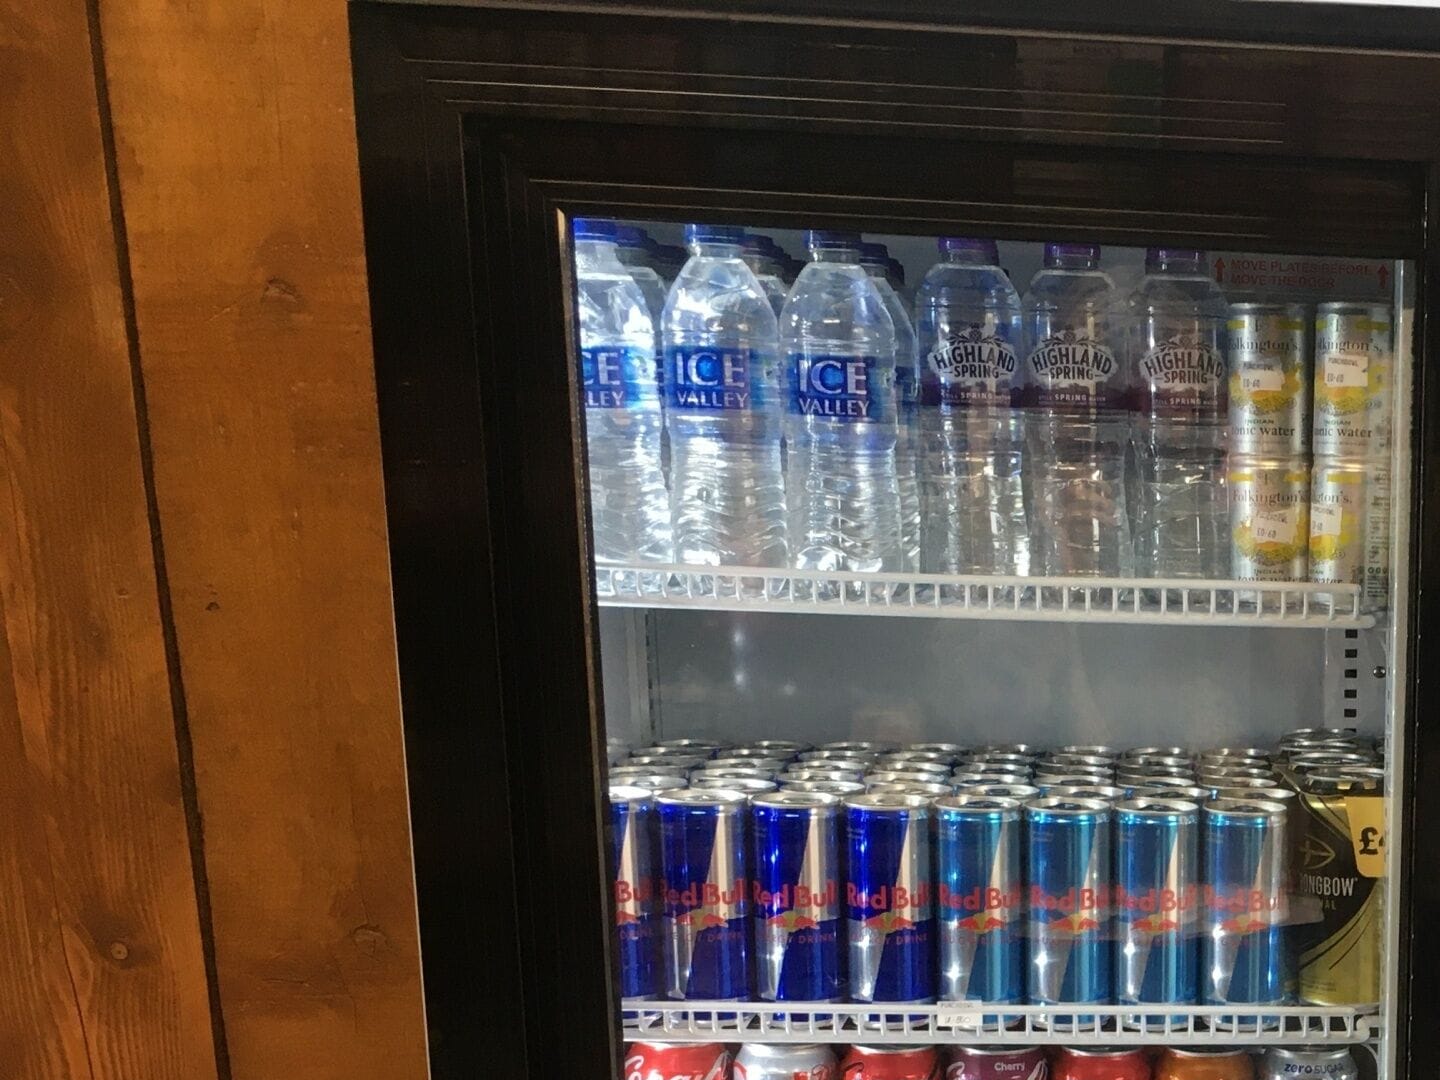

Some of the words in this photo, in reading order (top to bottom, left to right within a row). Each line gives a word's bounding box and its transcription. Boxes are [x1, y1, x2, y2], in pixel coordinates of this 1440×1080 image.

[934, 345, 1015, 372] HIGHLAND
[1032, 347, 1112, 375] HIGHLAND
[1144, 350, 1224, 379] HIGHLAND
[676, 353, 747, 388] ICE
[800, 361, 868, 396] ICE
[954, 364, 999, 379] SPRING
[1049, 366, 1094, 381] SPRING
[1164, 369, 1208, 384] SPRING
[677, 391, 749, 409] VALLEY
[799, 399, 871, 417] VALLEY
[1259, 426, 1295, 437] water
[1337, 427, 1373, 438] water
[752, 881, 789, 909] Red
[994, 1062, 1026, 1072] Cherry
[1284, 1062, 1312, 1074] zero
[1312, 1063, 1345, 1075] SUGAR
